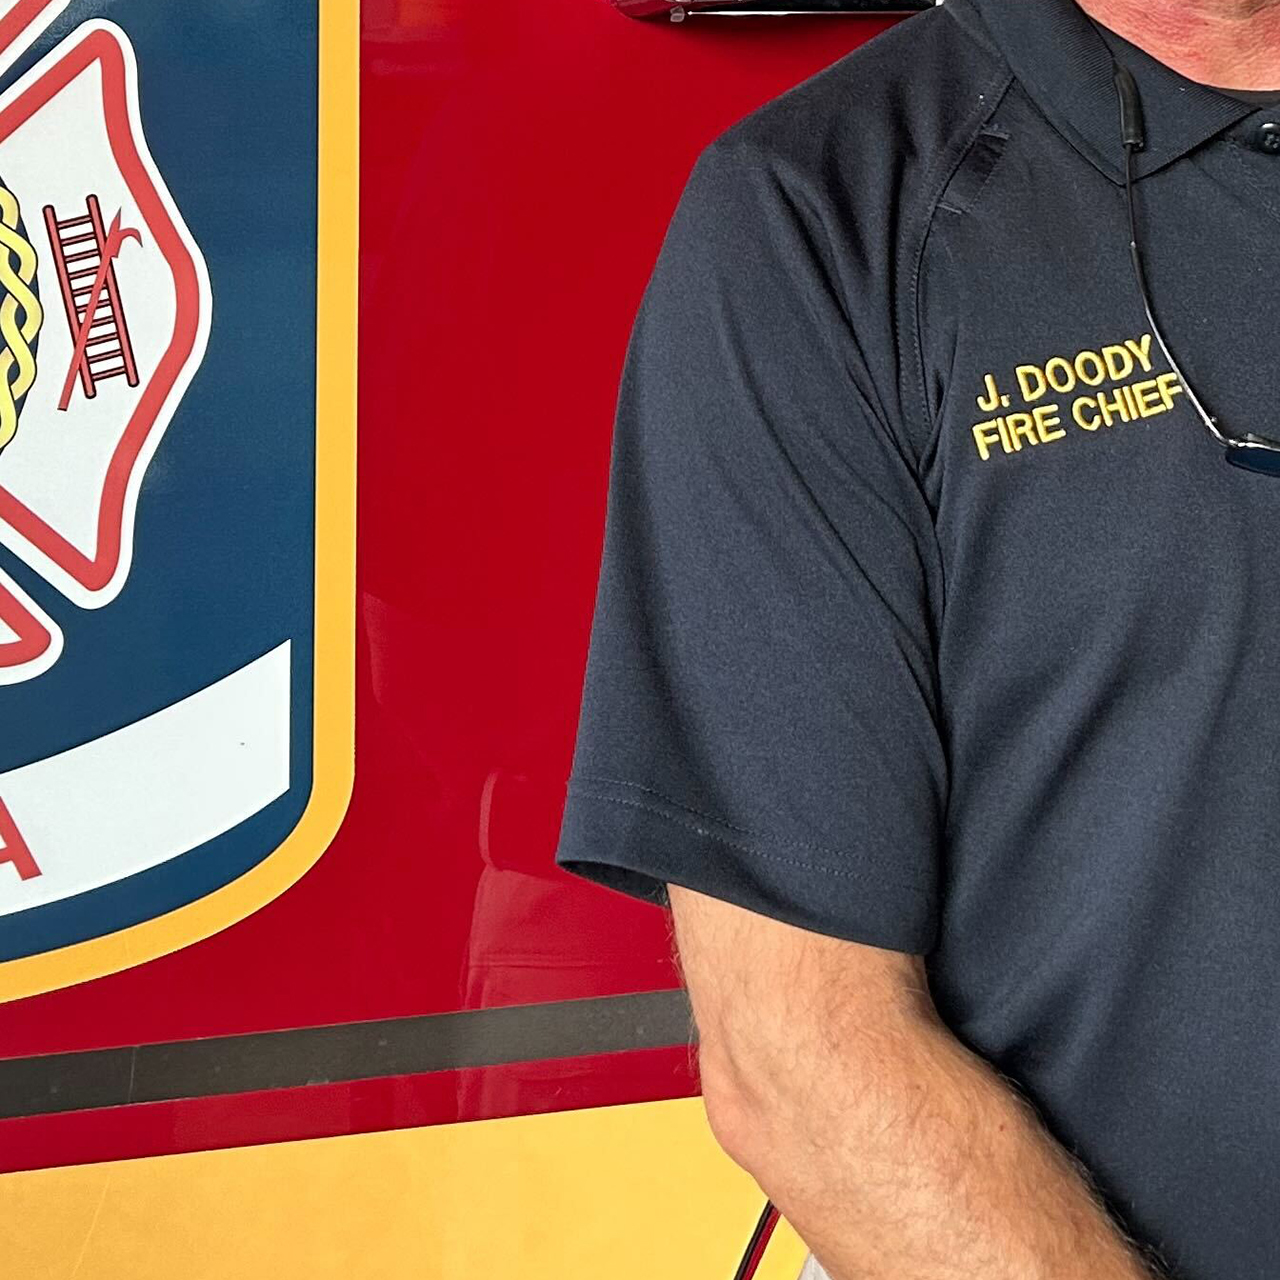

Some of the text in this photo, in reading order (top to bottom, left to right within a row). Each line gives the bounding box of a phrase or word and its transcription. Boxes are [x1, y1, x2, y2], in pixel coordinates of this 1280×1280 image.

[976, 333, 1153, 412] J. DOODY
[971, 372, 1184, 461] FIRE CHIEF
